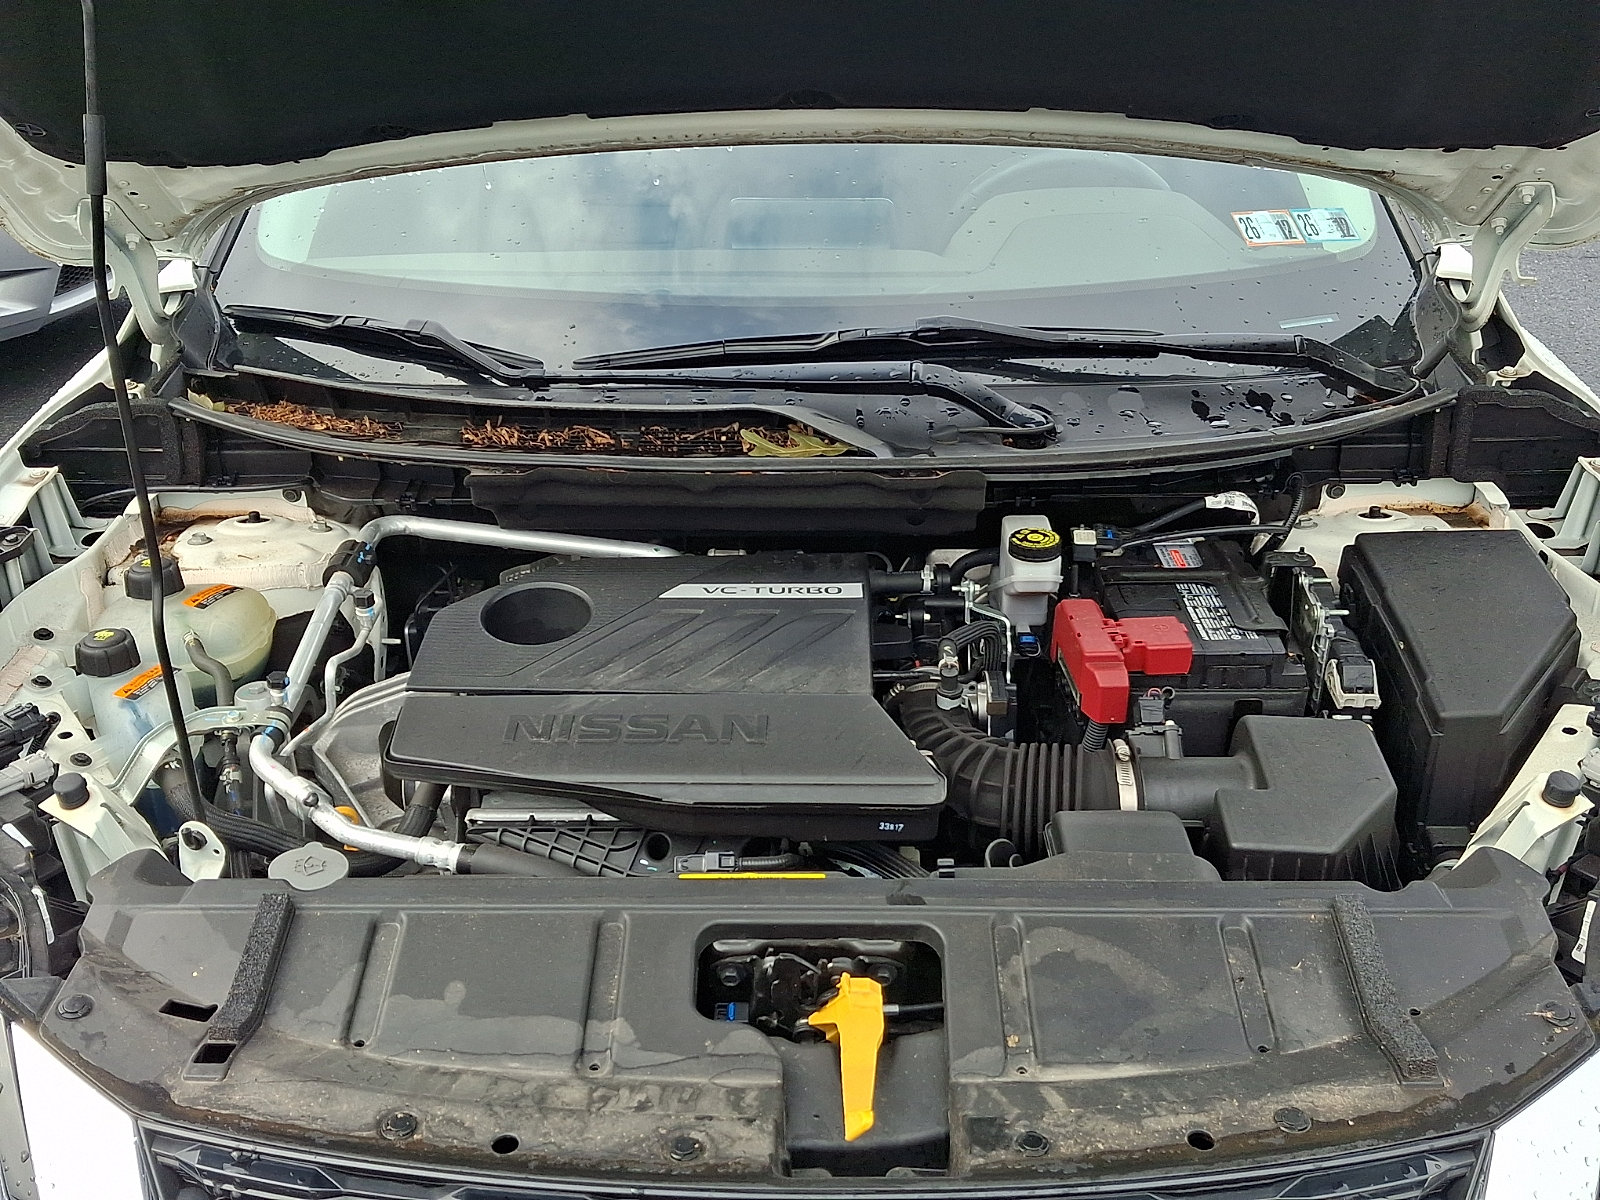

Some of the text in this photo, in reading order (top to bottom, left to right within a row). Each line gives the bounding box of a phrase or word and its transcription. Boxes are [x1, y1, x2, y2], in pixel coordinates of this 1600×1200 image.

[1238, 216, 1299, 240] 26 12
[1297, 213, 1320, 237] 26
[702, 585, 843, 596] VC-TURBO
[503, 714, 769, 744] NISSAN
